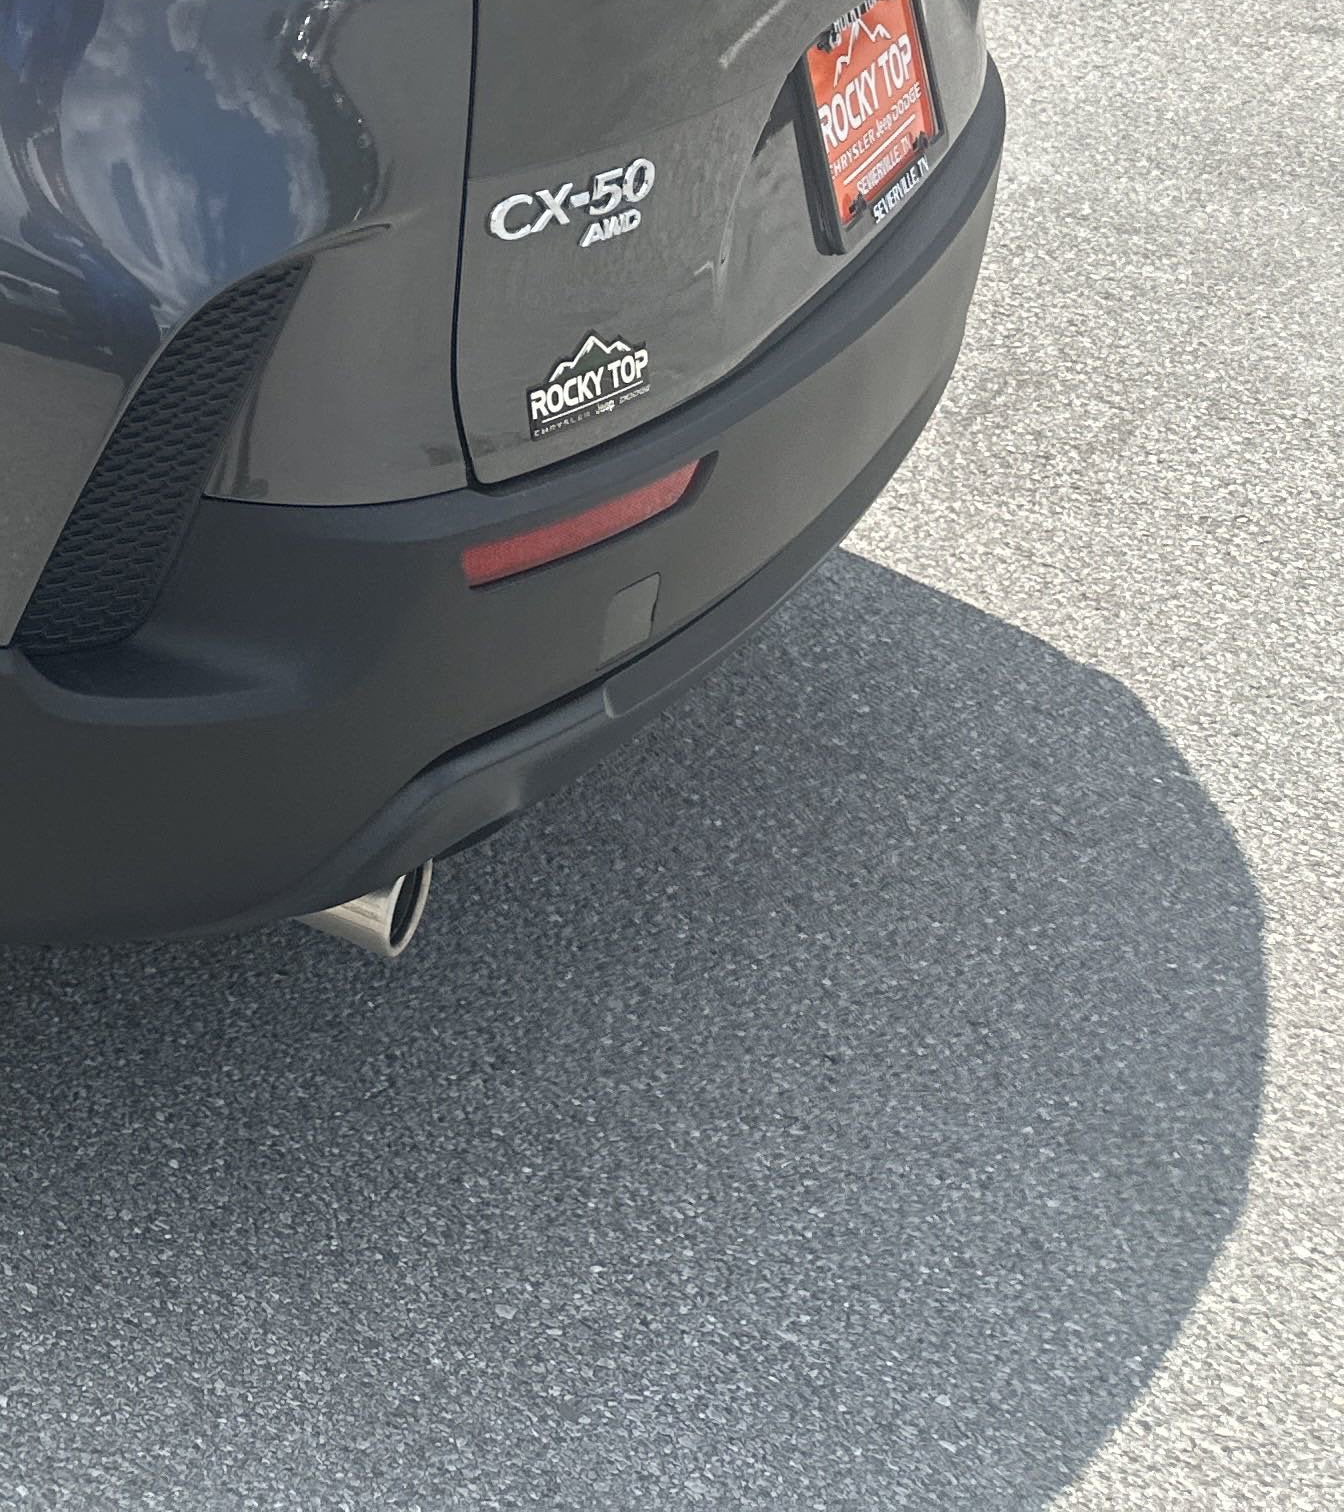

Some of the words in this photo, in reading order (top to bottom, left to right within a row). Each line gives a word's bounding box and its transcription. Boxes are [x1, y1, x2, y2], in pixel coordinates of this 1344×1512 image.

[818, 62, 879, 154] ROCKY
[878, 34, 912, 98] TOP
[891, 82, 922, 121] DODGE
[490, 158, 656, 240] CX-50
[579, 208, 642, 247] AWD
[530, 366, 604, 420] ROCKY
[607, 349, 649, 389] TOP
